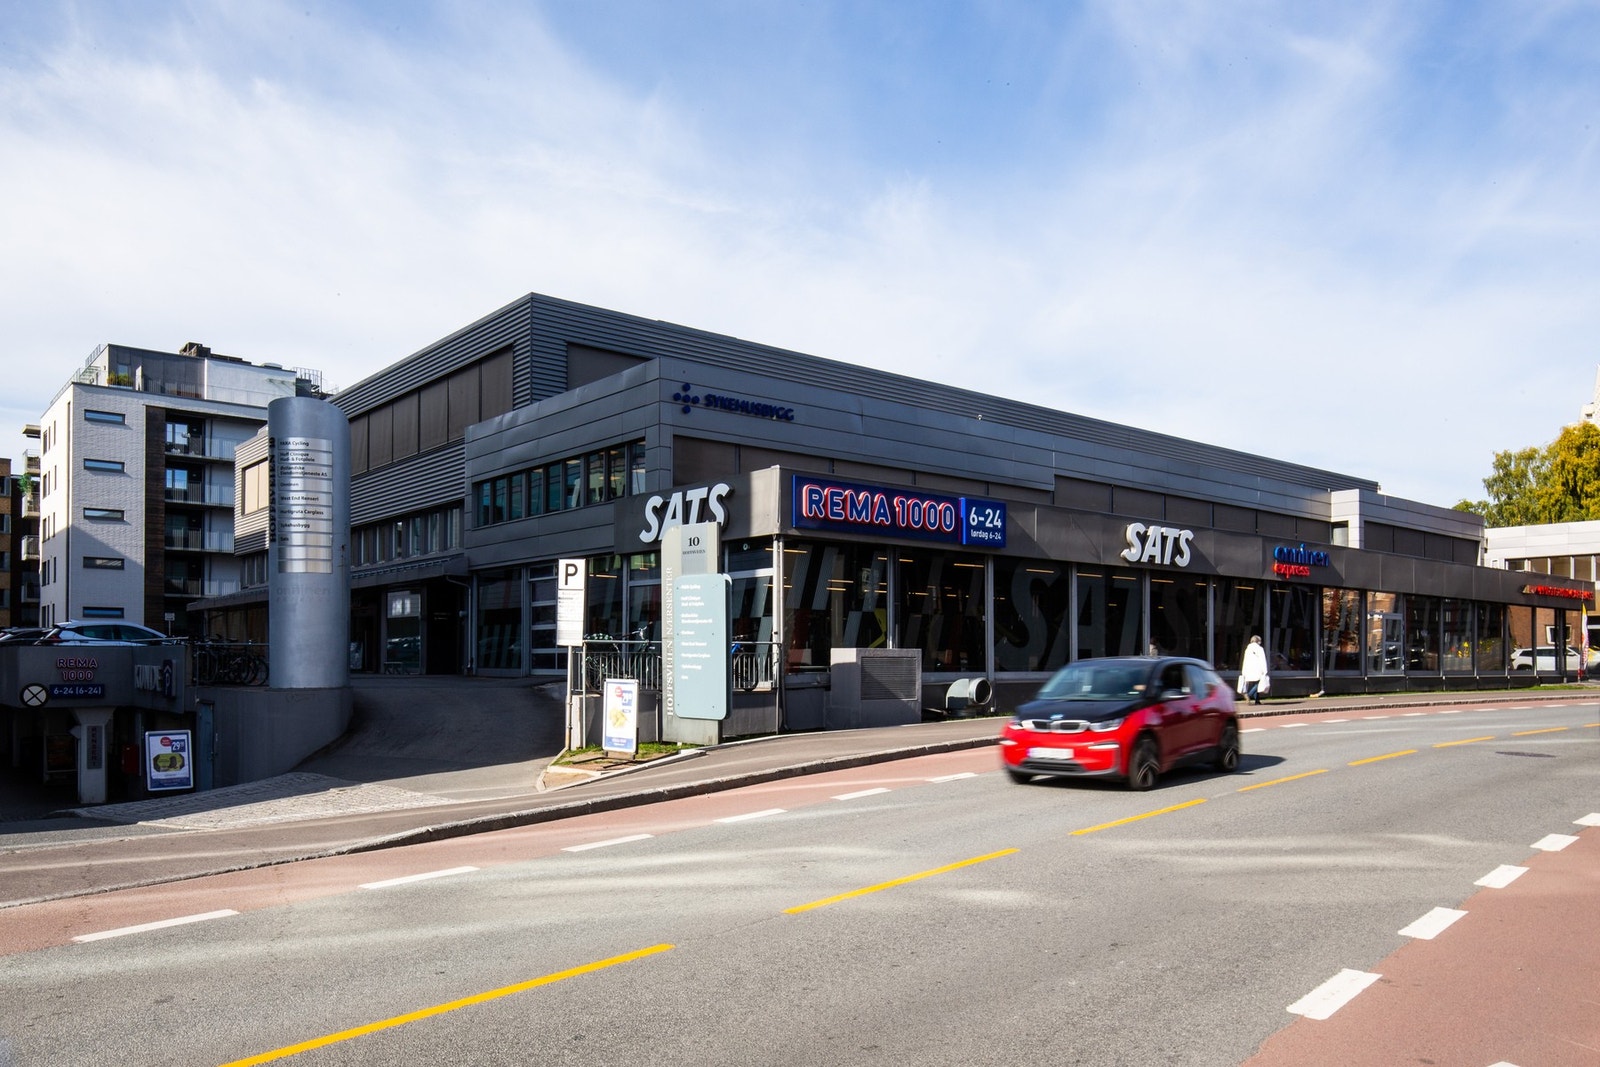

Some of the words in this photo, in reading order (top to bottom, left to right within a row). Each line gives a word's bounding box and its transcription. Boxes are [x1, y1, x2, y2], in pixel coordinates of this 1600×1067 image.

[704, 393, 794, 421] SYKEHUSBYGG
[638, 483, 733, 544] SATS
[803, 484, 891, 526] REMA
[894, 495, 955, 533] 1000
[969, 506, 1002, 529] 6-24
[688, 536, 700, 547] 10
[970, 529, 988, 541] lørdag
[989, 531, 1002, 541] 6-24
[1120, 522, 1194, 567] SATS
[564, 563, 578, 586] P
[1272, 562, 1310, 579] express
[57, 657, 98, 669] REMA
[62, 670, 93, 681] 1000
[666, 640, 674, 716] HOFFSVEIEN
[53, 686, 74, 695] 6-24
